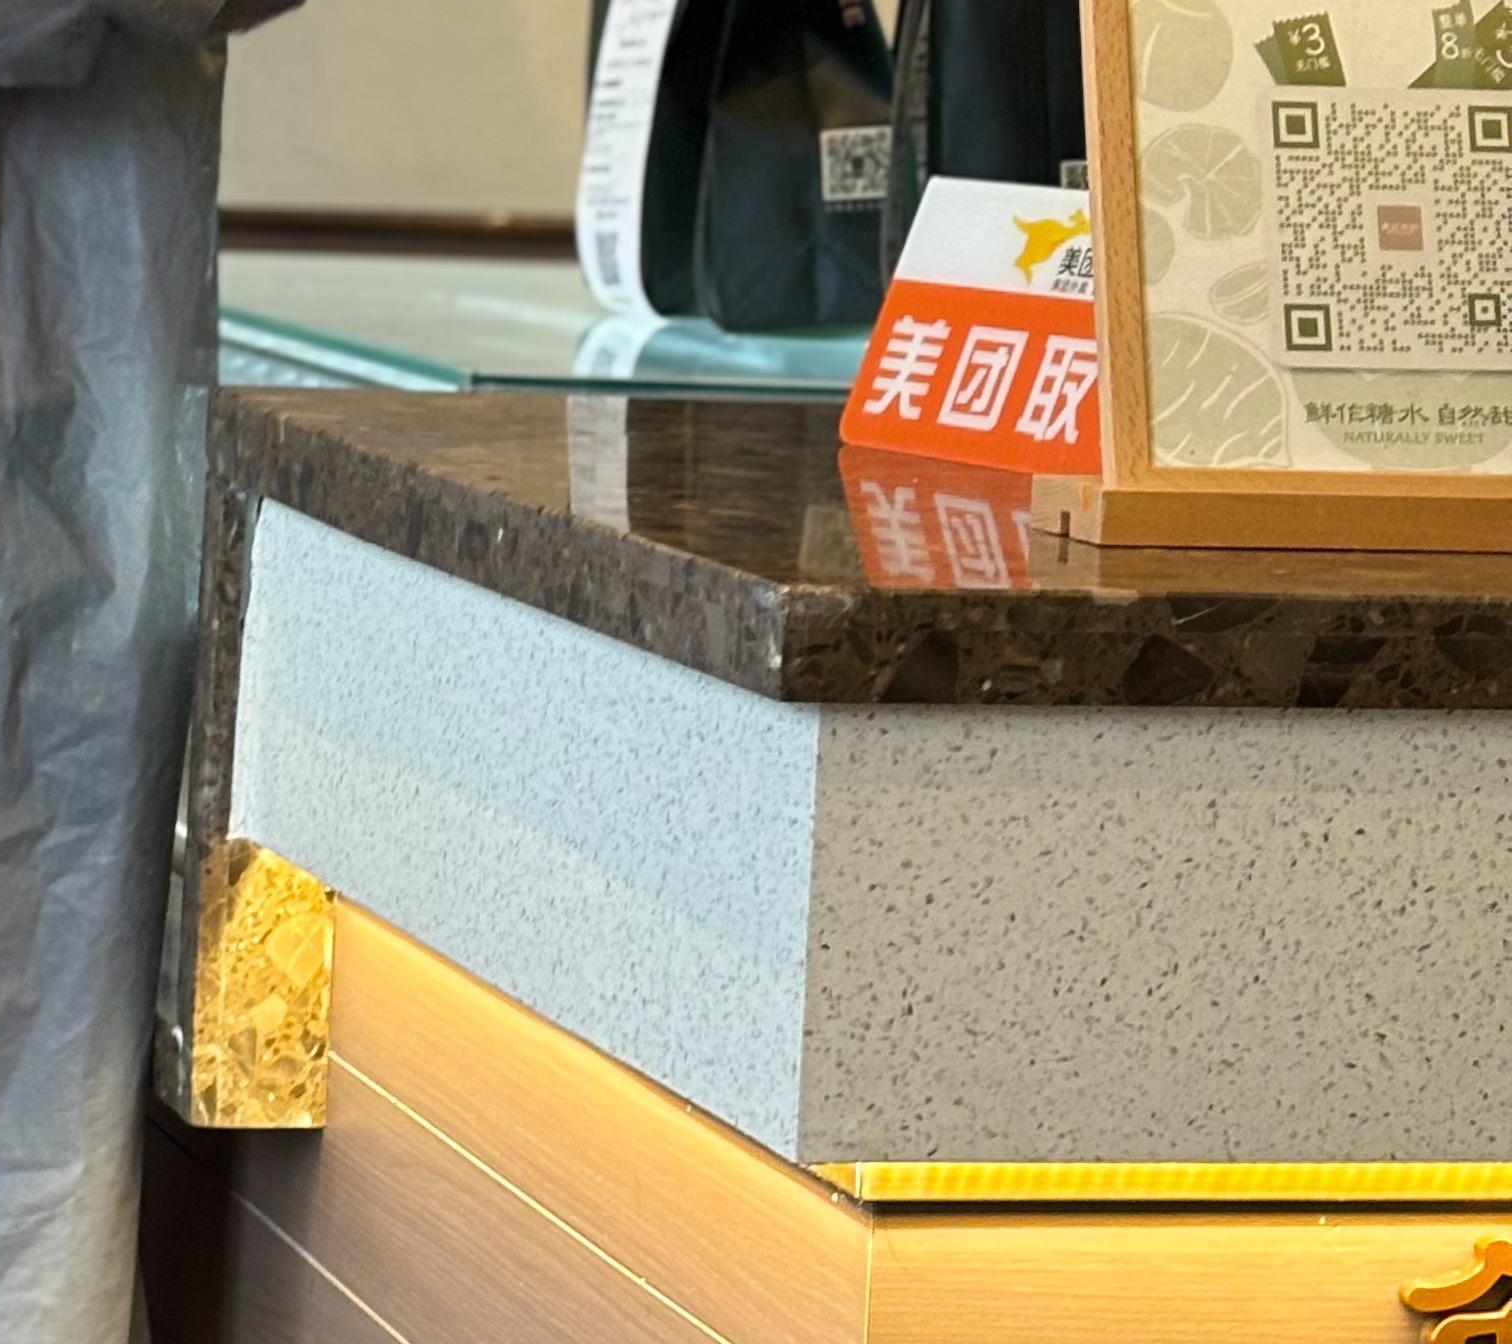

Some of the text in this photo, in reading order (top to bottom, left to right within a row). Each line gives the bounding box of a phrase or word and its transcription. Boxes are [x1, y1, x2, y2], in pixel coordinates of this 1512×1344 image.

[862, 314, 1099, 445] 美团取
[1343, 430, 1484, 445] NATURALLY SWEET
